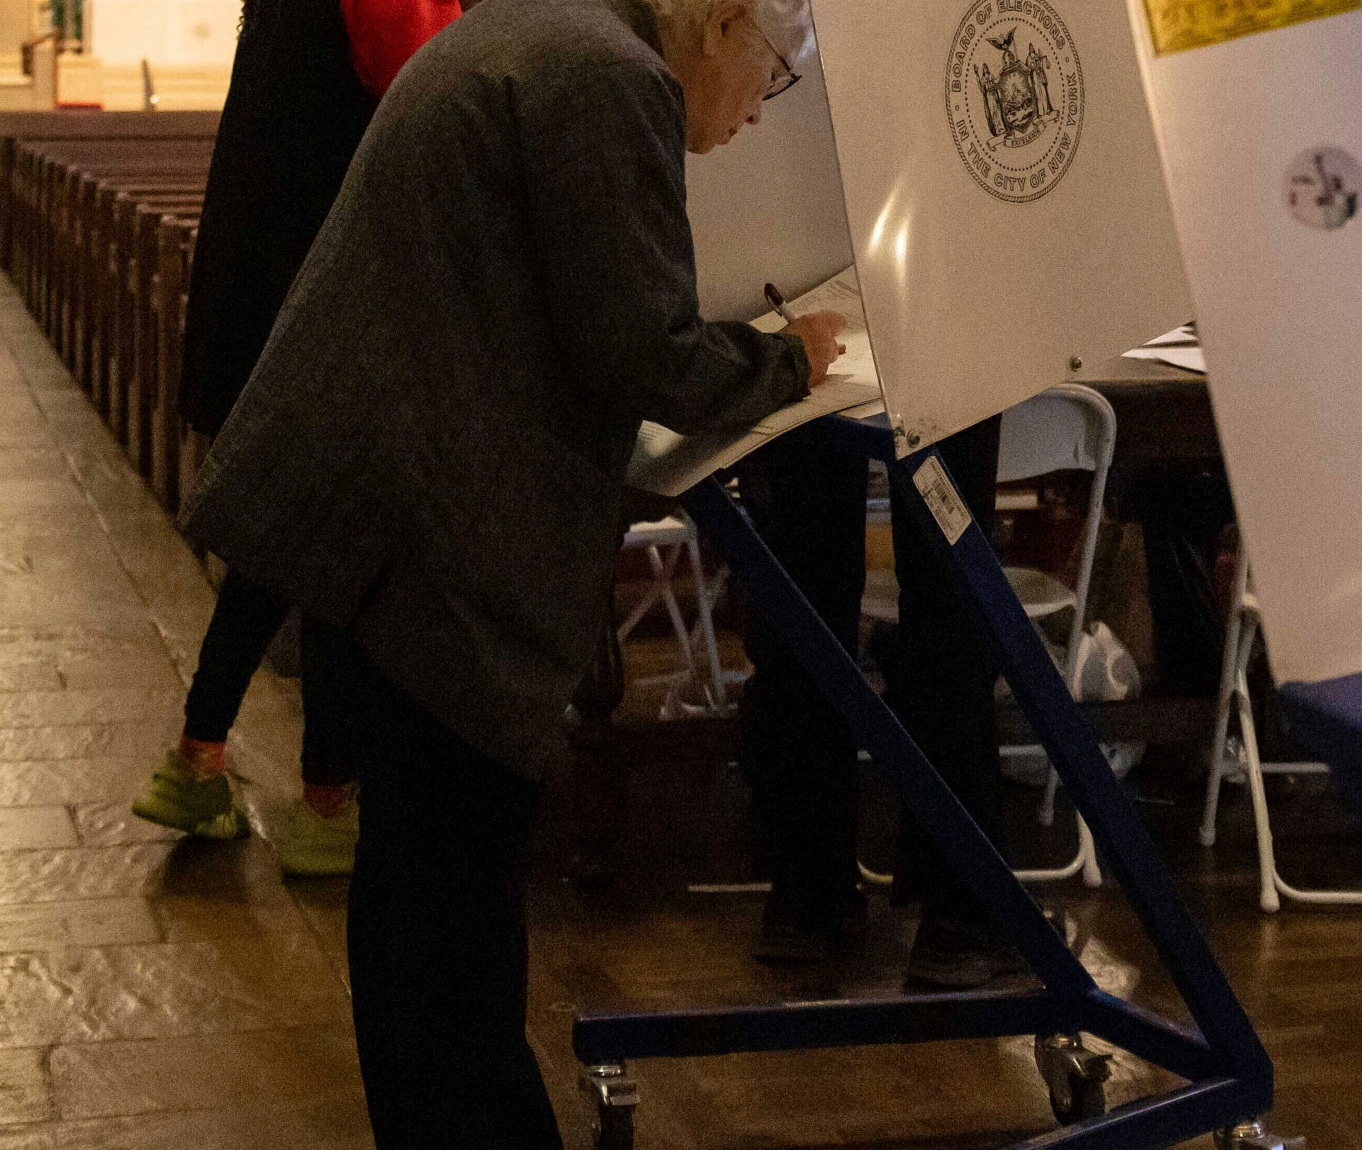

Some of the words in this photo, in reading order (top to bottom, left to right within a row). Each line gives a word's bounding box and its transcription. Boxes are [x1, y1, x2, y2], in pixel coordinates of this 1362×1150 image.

[952, 23, 976, 93] BOARD
[976, 4, 993, 25] OF
[956, 119, 970, 142] IN
[967, 142, 990, 178] THE
[994, 172, 1026, 192] CITY
[1029, 169, 1047, 188] OF
[1048, 132, 1072, 176] NEW
[1066, 71, 1078, 127] YORK
